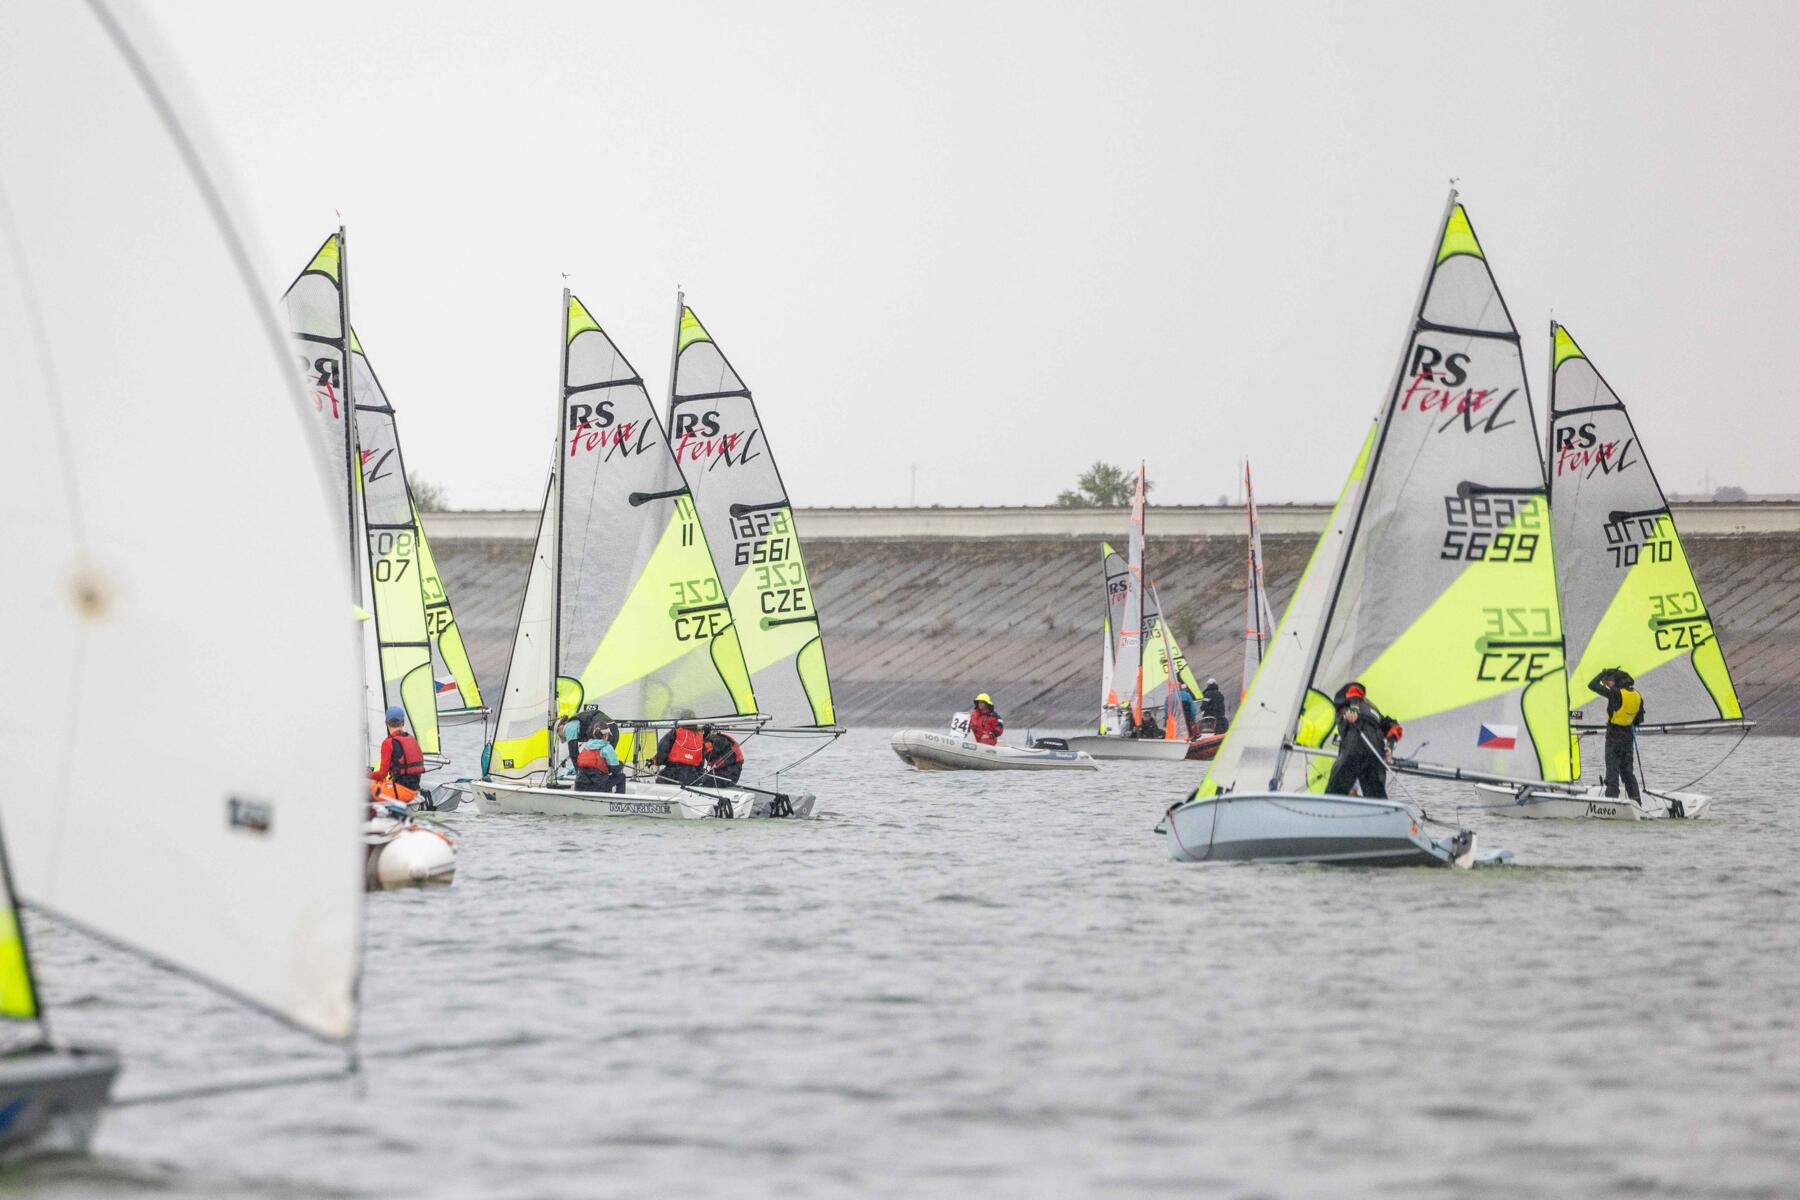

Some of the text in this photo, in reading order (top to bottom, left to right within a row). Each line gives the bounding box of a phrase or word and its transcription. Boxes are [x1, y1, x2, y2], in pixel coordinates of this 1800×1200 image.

[1410, 344, 1471, 388] RS
[569, 401, 615, 430] RS
[1401, 371, 1519, 434] Feva XL
[570, 418, 638, 457] Feva
[675, 410, 721, 439] RS
[1556, 422, 1597, 452] RS
[676, 428, 744, 464] Feva
[1557, 439, 1618, 477] Feva
[682, 523, 693, 547] 11
[1440, 530, 1540, 563] 5699
[734, 537, 790, 566] 6561
[1606, 540, 1672, 568] 7070
[760, 587, 807, 614] CZE
[1109, 580, 1127, 594] RS
[426, 610, 447, 635] ZE
[675, 612, 724, 641] CZE
[1654, 624, 1706, 651] CZE
[1476, 653, 1550, 682] CZE
[951, 718, 968, 732] 34
[609, 801, 672, 814] MARINE
[1586, 801, 1617, 816] Marco
